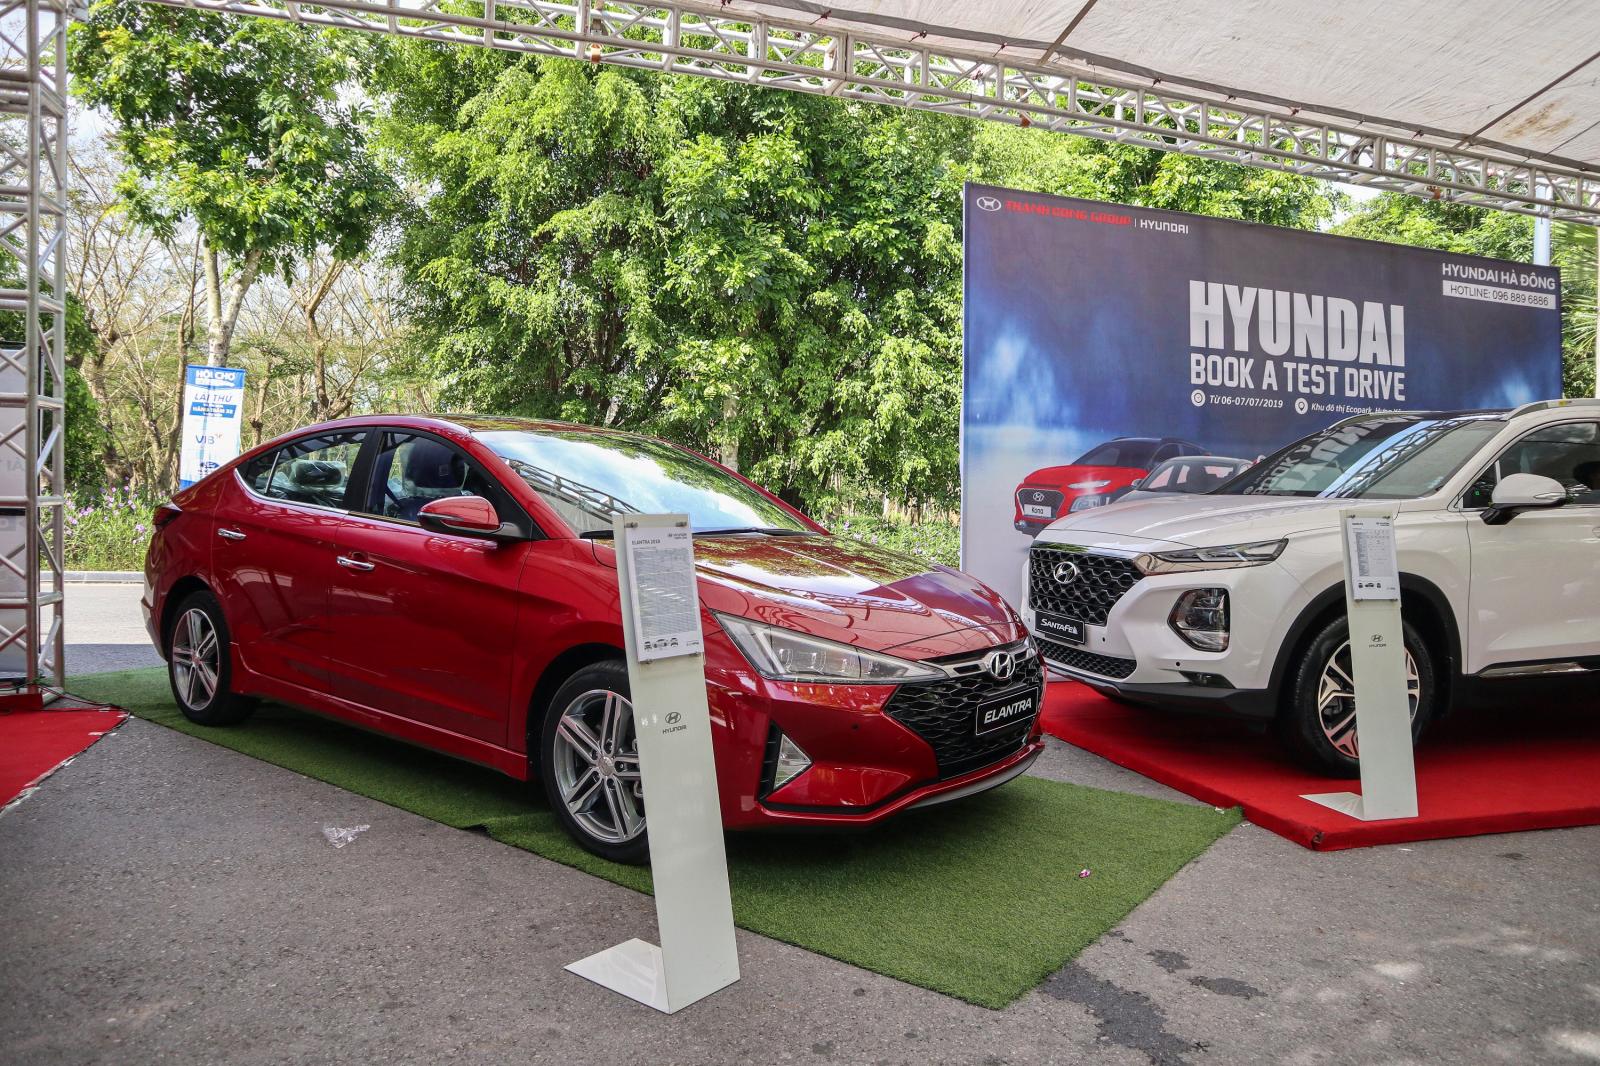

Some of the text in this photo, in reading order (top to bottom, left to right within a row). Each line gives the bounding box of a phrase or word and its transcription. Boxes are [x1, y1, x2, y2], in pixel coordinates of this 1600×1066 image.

[1140, 219, 1188, 234] HYUNDAI
[1442, 262, 1498, 284] HYUNDAI
[1501, 268, 1518, 286] HÀ
[1450, 284, 1548, 306] HOTLINE: 096 889 6886
[1190, 280, 1405, 367] HYUNDAI
[1190, 352, 1406, 401] BOOK A TEST DRIVE
[1221, 396, 1284, 408] 06-07/07/2019
[1311, 402, 1324, 411] Khu
[1032, 506, 1044, 514] Kona
[984, 698, 1032, 724] ELANTRA
